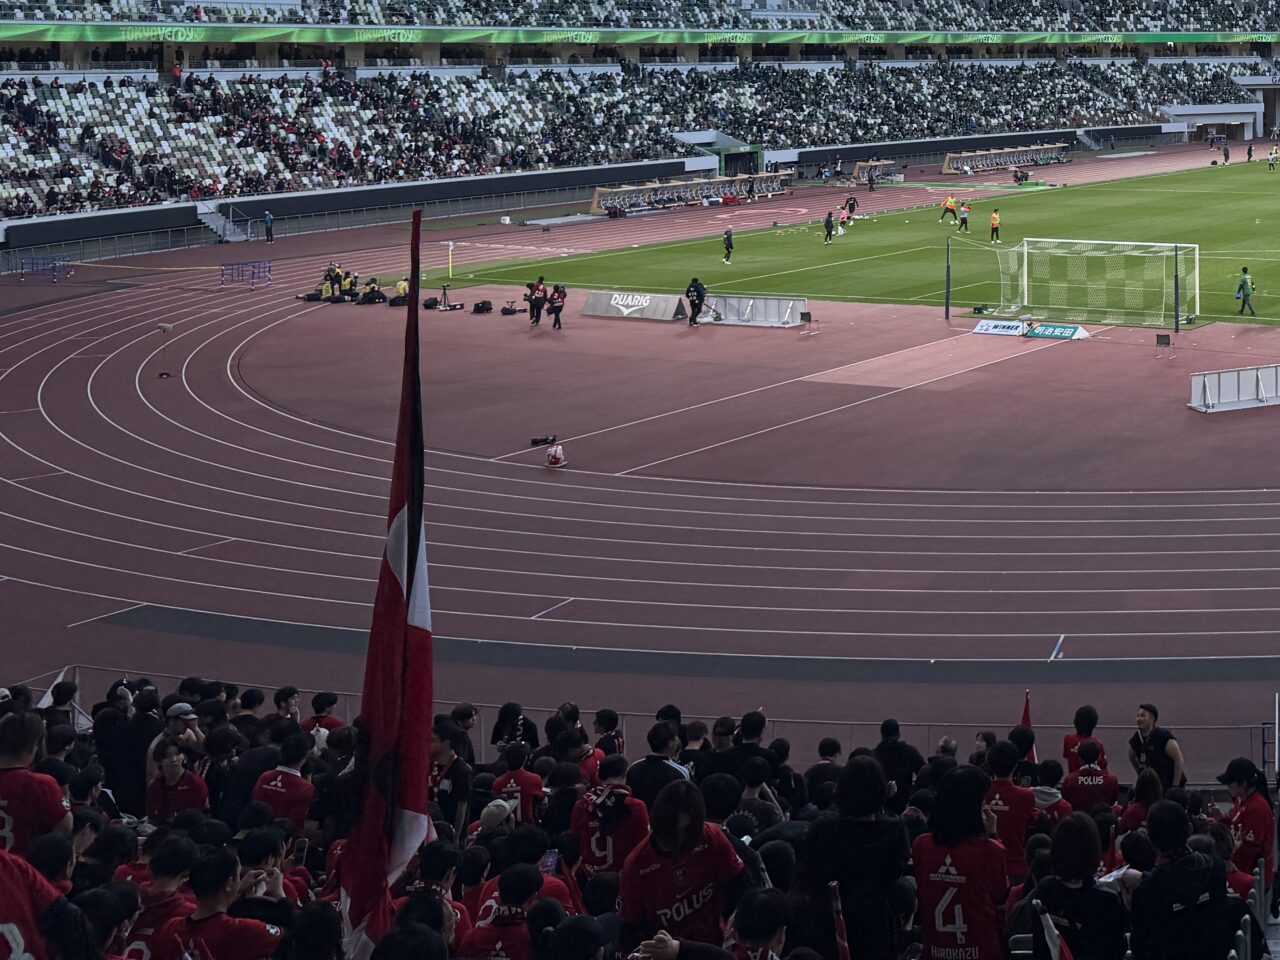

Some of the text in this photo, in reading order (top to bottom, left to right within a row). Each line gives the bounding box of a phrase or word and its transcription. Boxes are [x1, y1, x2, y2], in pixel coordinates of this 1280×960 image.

[611, 293, 652, 306] DUARIG
[1034, 326, 1075, 336] 明治安田
[1078, 775, 1104, 785] POLUS
[591, 831, 613, 870] 9
[656, 883, 713, 928] POLUS
[935, 887, 968, 944] 4
